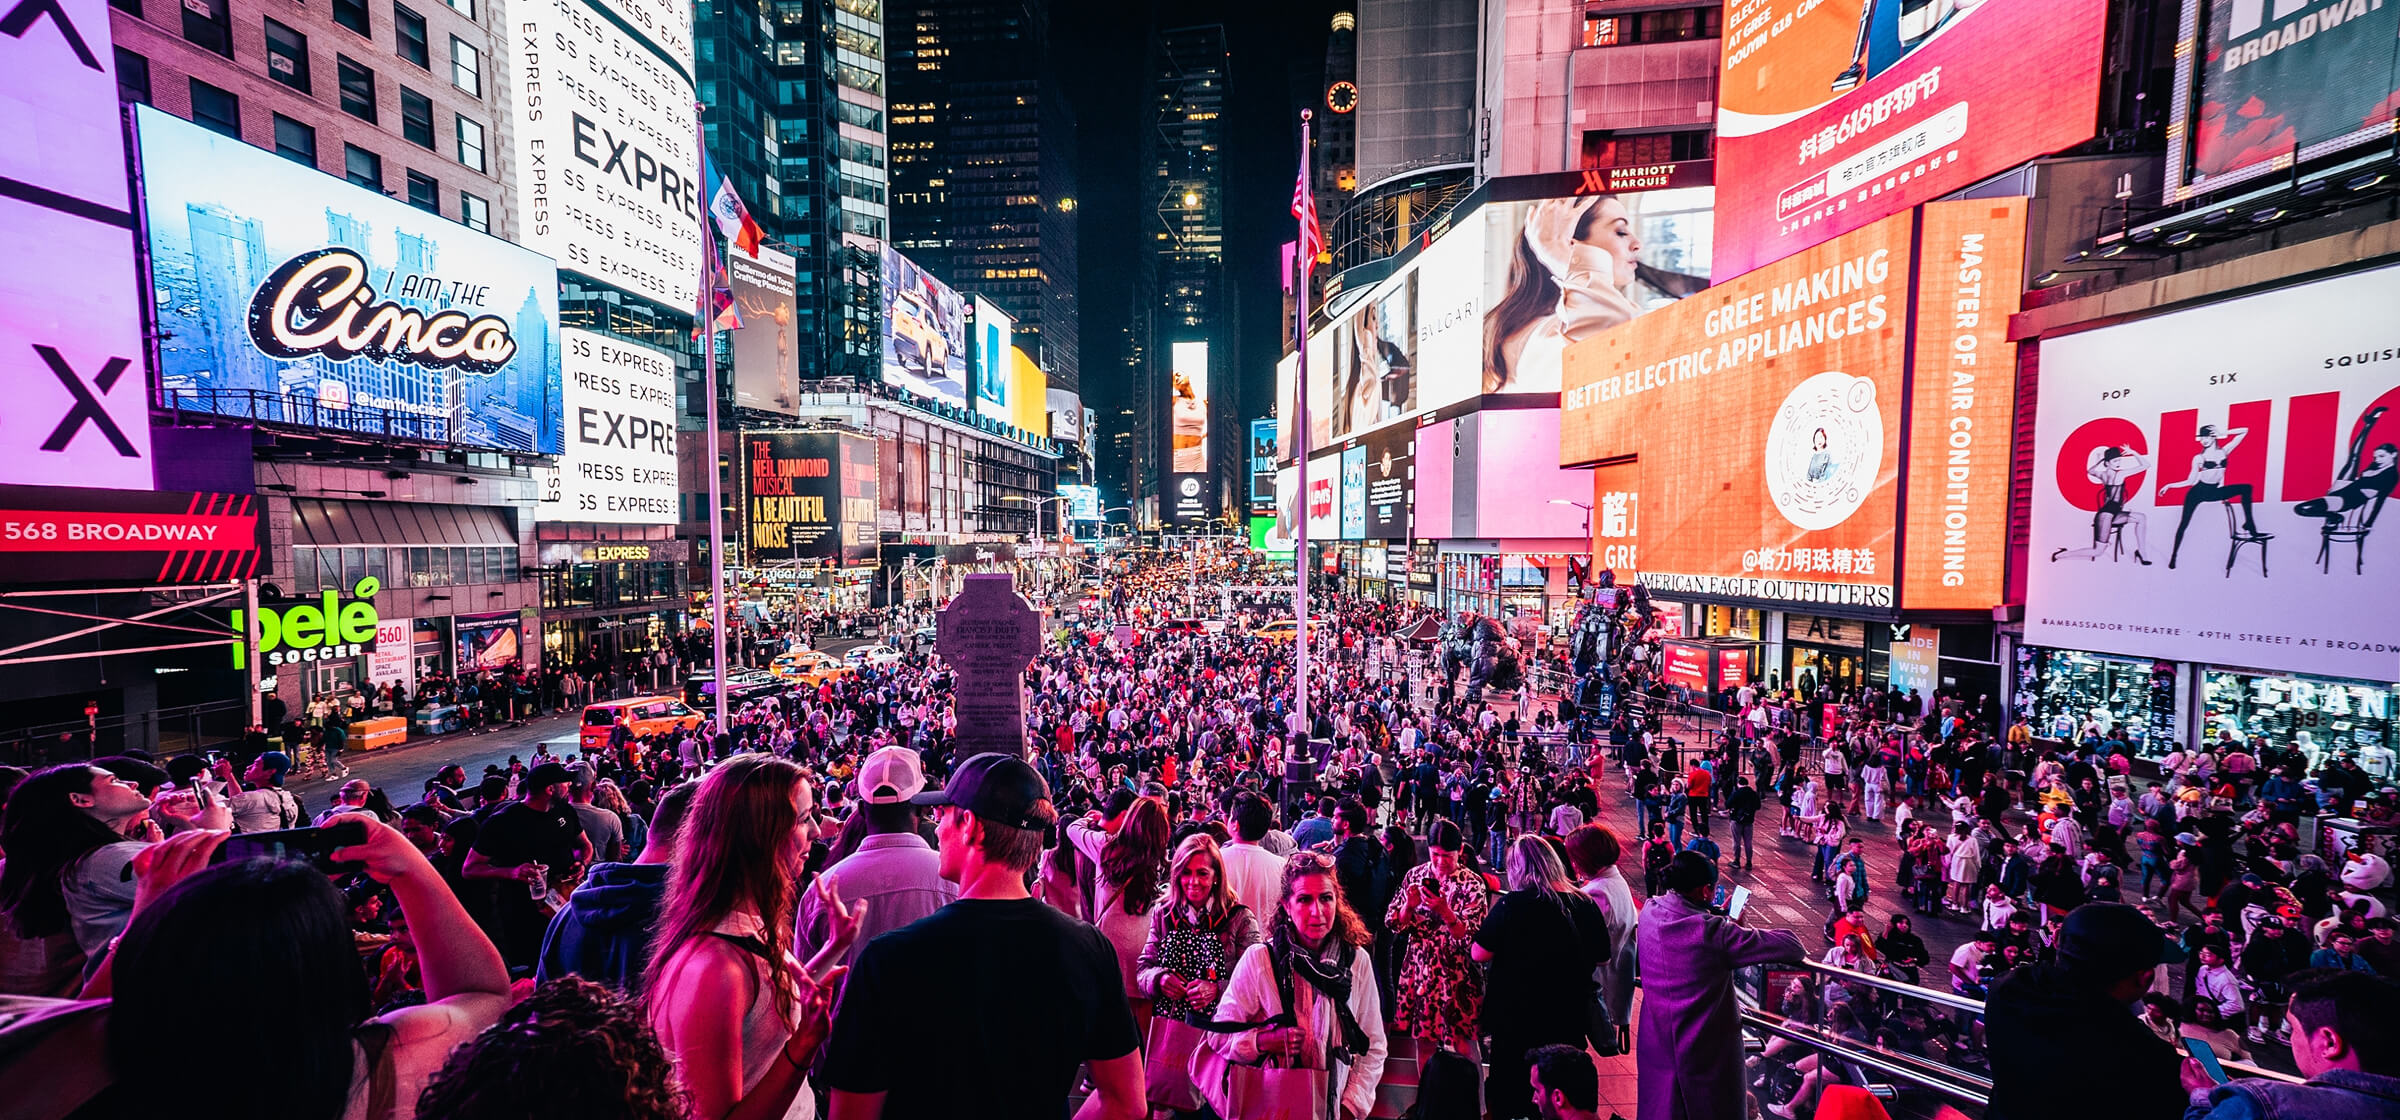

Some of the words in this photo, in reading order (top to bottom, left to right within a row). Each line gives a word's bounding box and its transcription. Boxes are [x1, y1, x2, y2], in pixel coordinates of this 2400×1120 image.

[1728, 29, 1742, 50] AT
[1743, 6, 1772, 38] GREE
[1728, 30, 1768, 70] DOUYIN
[523, 22, 542, 122] EXPRESS
[589, 54, 657, 111] EXPRESS
[1611, 165, 1676, 178] MARRIOTT
[1611, 176, 1667, 189] MARQUIS
[531, 139, 549, 236] EXPRESS
[597, 184, 663, 229] EXPRESS
[624, 231, 684, 271] EXPRESS
[600, 255, 666, 294] EXPRESS
[733, 261, 767, 279] Guillermo
[767, 272, 777, 281] del
[733, 270, 761, 288] Crafting
[762, 279, 793, 296] Pinocchio
[1956, 233, 1985, 329] MASTER
[385, 270, 394, 294] I
[402, 274, 436, 300] AM
[447, 280, 490, 308] THE
[1705, 303, 1762, 338] GREE
[1772, 248, 1889, 318] MAKING
[270, 252, 516, 366] Cinco
[601, 346, 664, 377] EXPRESS
[1567, 377, 1620, 411] BETTER
[1624, 348, 1712, 394] ELECTRIC
[1716, 294, 1887, 371] APPLIANCES
[1954, 334, 1978, 366] OF
[574, 372, 621, 395] RESS
[1950, 372, 1976, 411] AIR
[2210, 373, 2238, 385] SIX
[2102, 388, 2130, 401] POP
[579, 406, 675, 456] EXPRE
[981, 414, 1051, 450] BROADWAY
[752, 441, 771, 460] THE
[578, 463, 624, 482] RESS
[752, 459, 776, 478] NEIL
[777, 458, 830, 478] DIAMOND
[752, 477, 796, 496] MUSICAL
[608, 495, 669, 514] EXPRESS
[752, 496, 762, 522] A
[763, 496, 827, 522] BEAUTIFUL
[1943, 416, 1973, 588] CONDITIONING
[5, 522, 58, 541] 568
[68, 522, 218, 541] BROADWAY
[752, 522, 789, 549] NOISE
[598, 546, 649, 560] EXPRESS
[1742, 546, 1876, 575] @格力明珠精选
[1635, 571, 1704, 593] AMERICAN
[1709, 576, 1758, 598] EAGLE
[1764, 580, 1890, 606] OUTFITTERS
[231, 576, 380, 670] pelé
[1808, 615, 1841, 639] AE
[2129, 624, 2180, 636] THEATRE
[2197, 630, 2231, 641] 49TH
[2239, 632, 2291, 645] STREET
[2299, 638, 2318, 647] AT
[269, 643, 362, 666] SOCCER
[1896, 637, 1934, 649] RIDE
[1907, 650, 1920, 660] IN
[375, 655, 407, 664] RESTAURANT
[375, 668, 402, 677] AVAILABLE
[1907, 676, 1927, 689] AM
